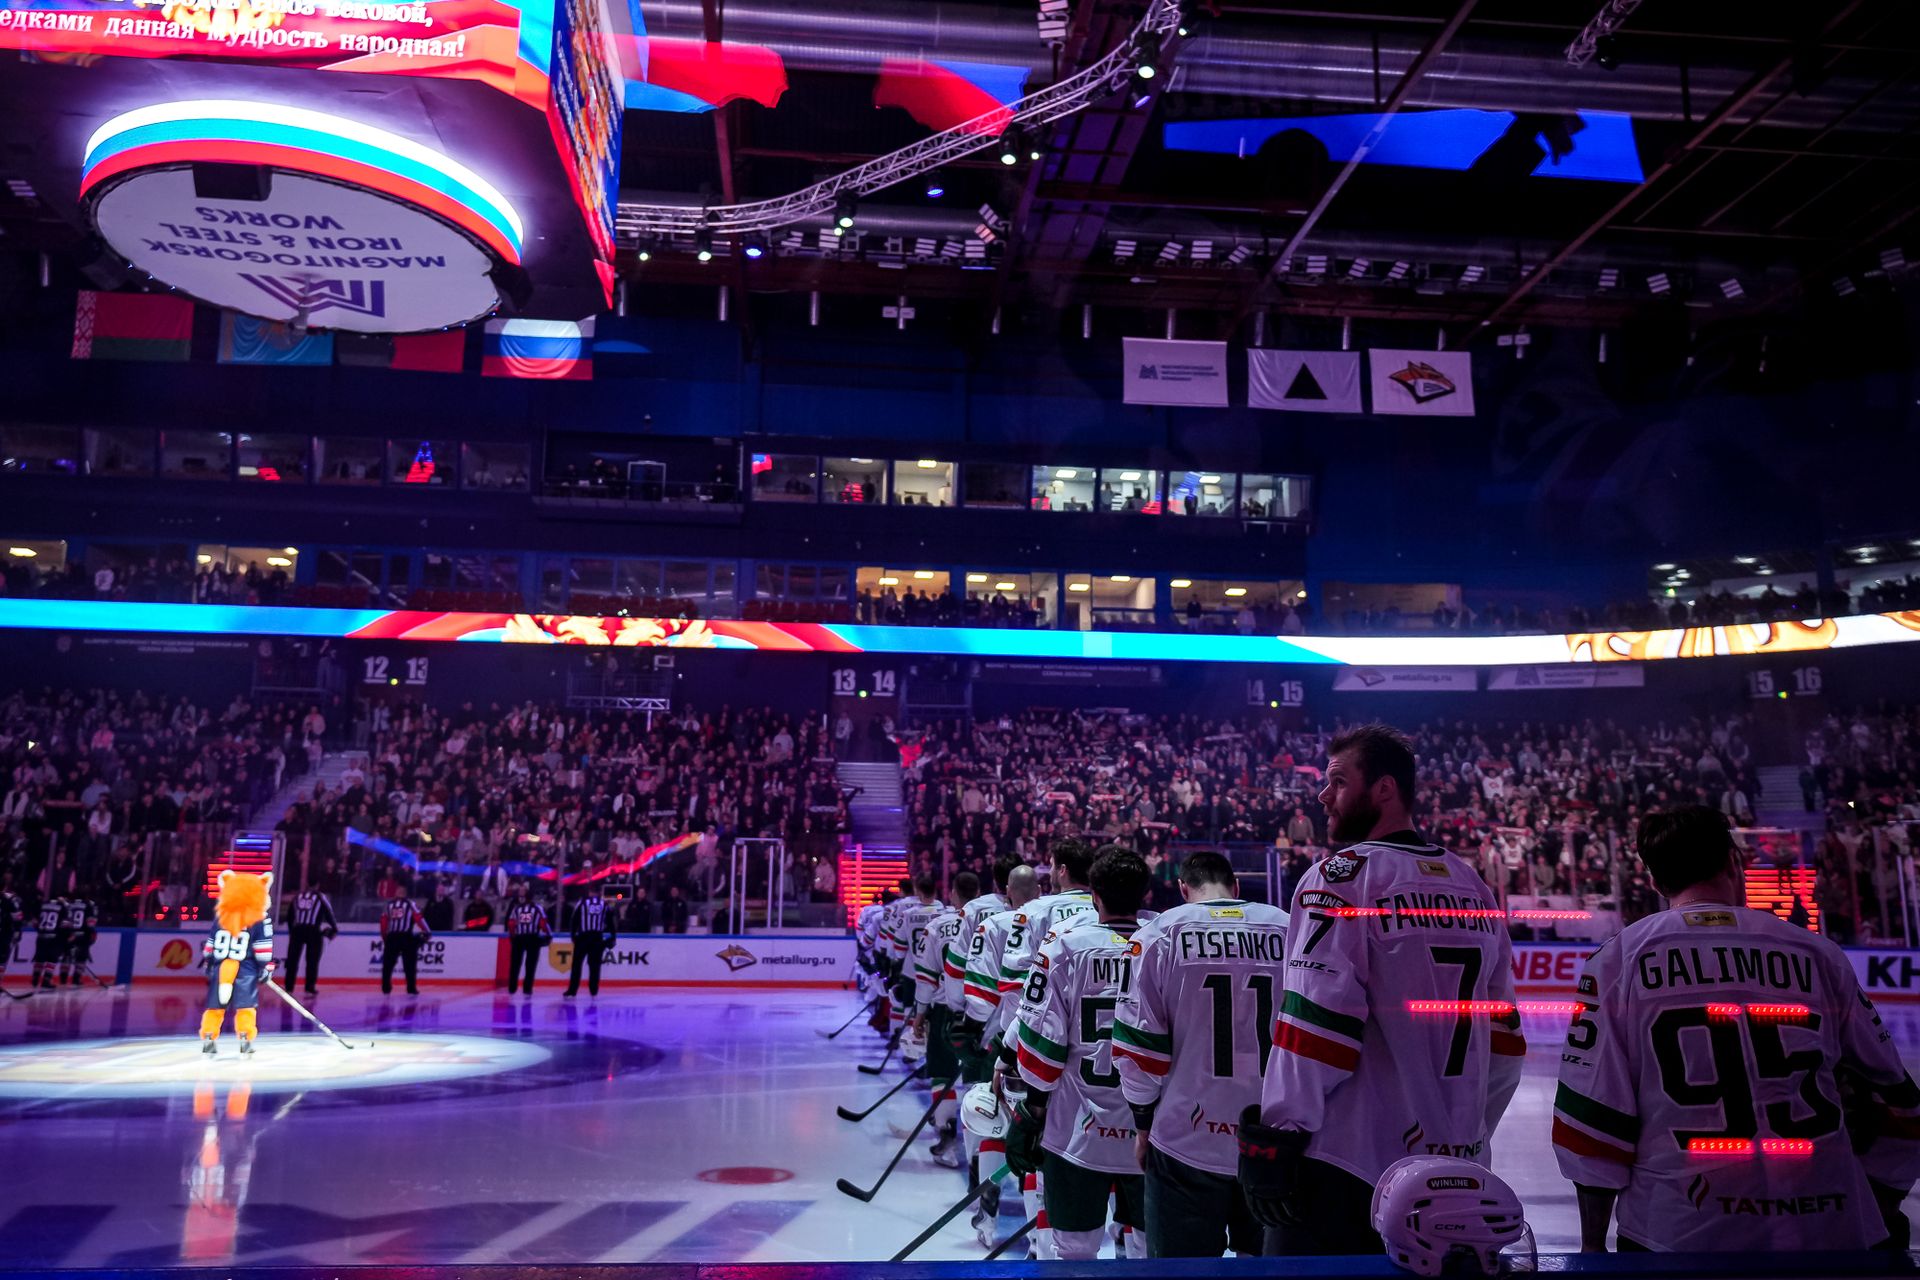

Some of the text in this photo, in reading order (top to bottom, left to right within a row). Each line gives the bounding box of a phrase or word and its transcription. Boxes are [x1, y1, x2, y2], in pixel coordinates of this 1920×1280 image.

[104, 17, 195, 40] данная
[206, 23, 329, 48] мудрость
[339, 33, 466, 57] народная!
[196, 206, 345, 230] WORKS
[158, 222, 402, 251] IRON & STEEL
[142, 238, 446, 268] MAGNITOGORSK
[364, 656, 389, 678] 12
[407, 657, 429, 679] 13
[1792, 667, 1822, 690] 16
[832, 668, 856, 690] 13
[872, 670, 896, 691] 14
[1745, 670, 1774, 693] 15
[1280, 680, 1304, 702] 15
[1303, 893, 1345, 909] WINLINE
[213, 929, 250, 960] 99
[1007, 925, 1025, 948] 3
[1303, 912, 1335, 955] 7
[1181, 930, 1283, 961] FISENKO
[762, 955, 836, 967] metallurg.ru
[1289, 960, 1328, 971] SOYUZ
[1638, 946, 1813, 994] GALIMOV
[1429, 946, 1483, 1077] 7
[1202, 974, 1275, 1078] 11
[1651, 1007, 1842, 1153] 95
[1097, 1126, 1137, 1139] TATN
[1425, 1138, 1485, 1158] TATNE
[1430, 1179, 1469, 1188] WINLINE
[1715, 1193, 1848, 1217] TATNEFT
[1434, 1223, 1466, 1231] CCM
